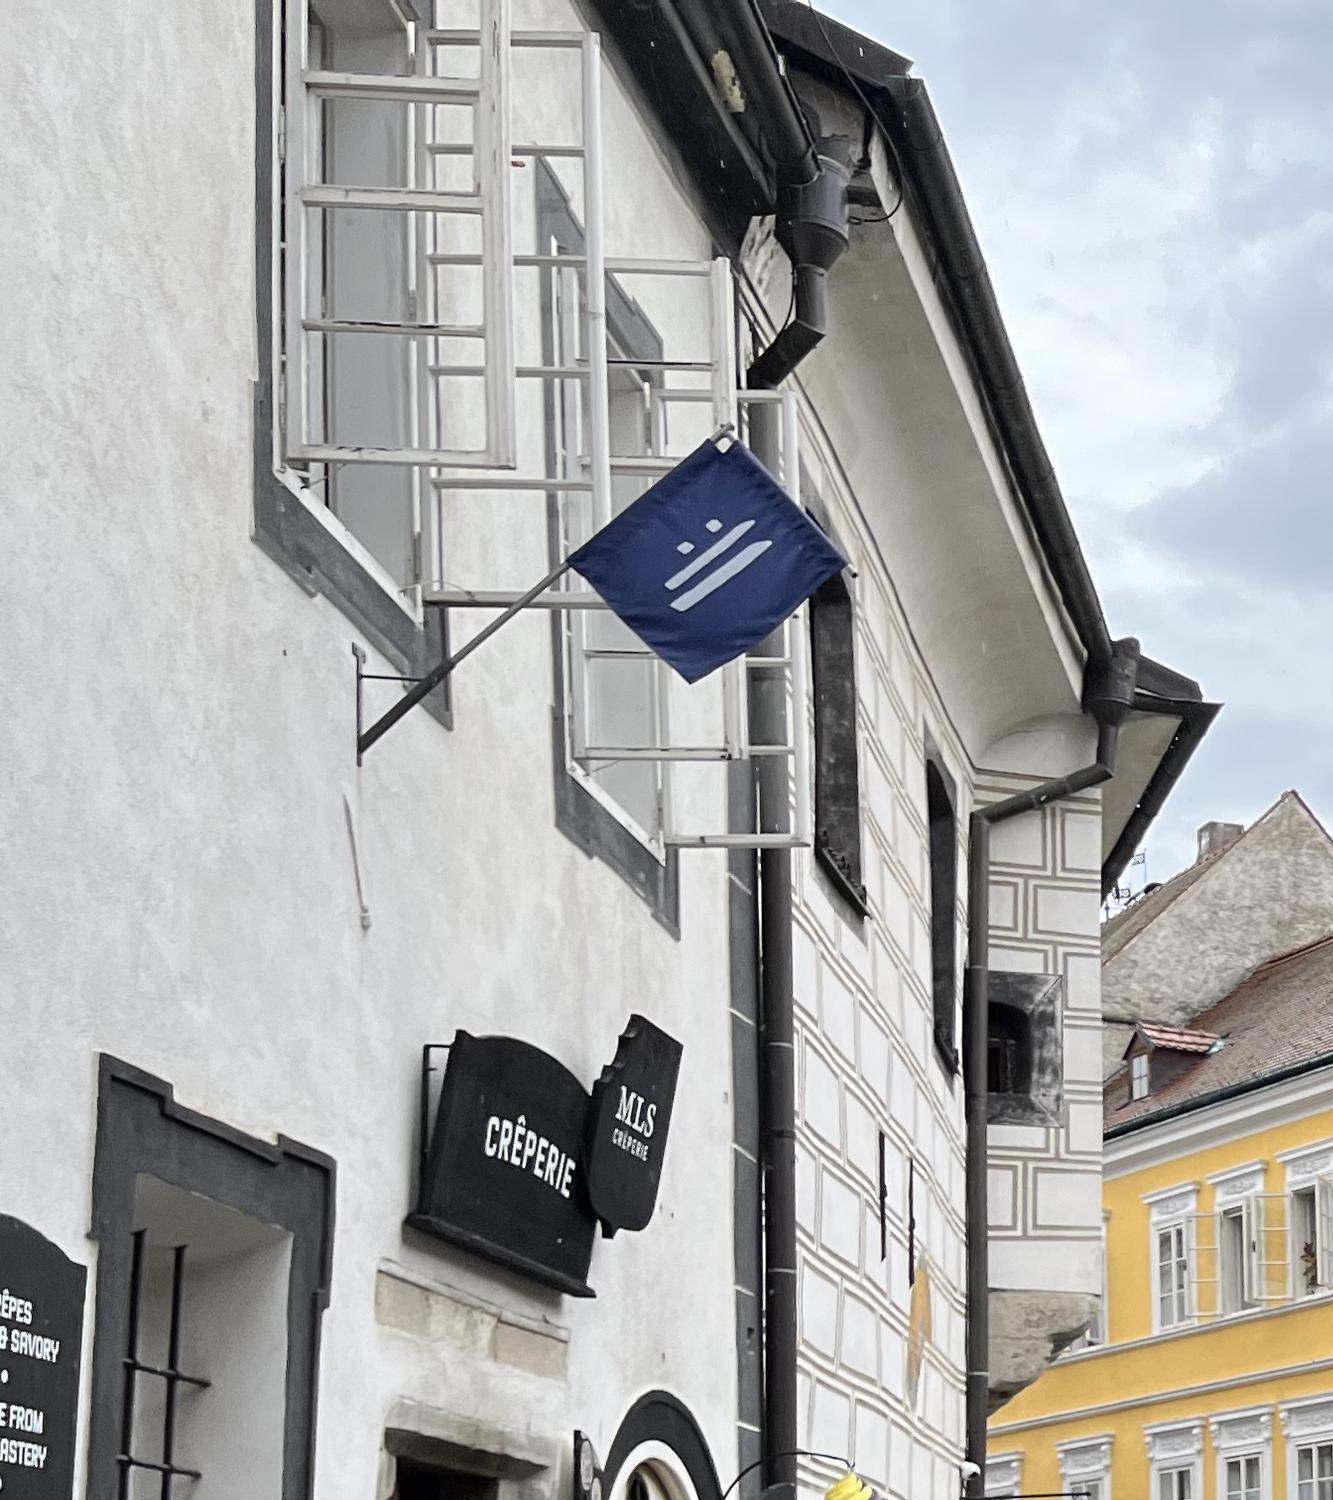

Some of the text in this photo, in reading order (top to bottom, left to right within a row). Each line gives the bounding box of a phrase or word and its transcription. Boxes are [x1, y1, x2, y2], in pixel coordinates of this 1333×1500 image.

[614, 1085, 657, 1138] MLS
[484, 1114, 576, 1199] CRÊPERIE
[11, 1329, 60, 1363] SAVORY
[9, 1405, 43, 1434] FROM
